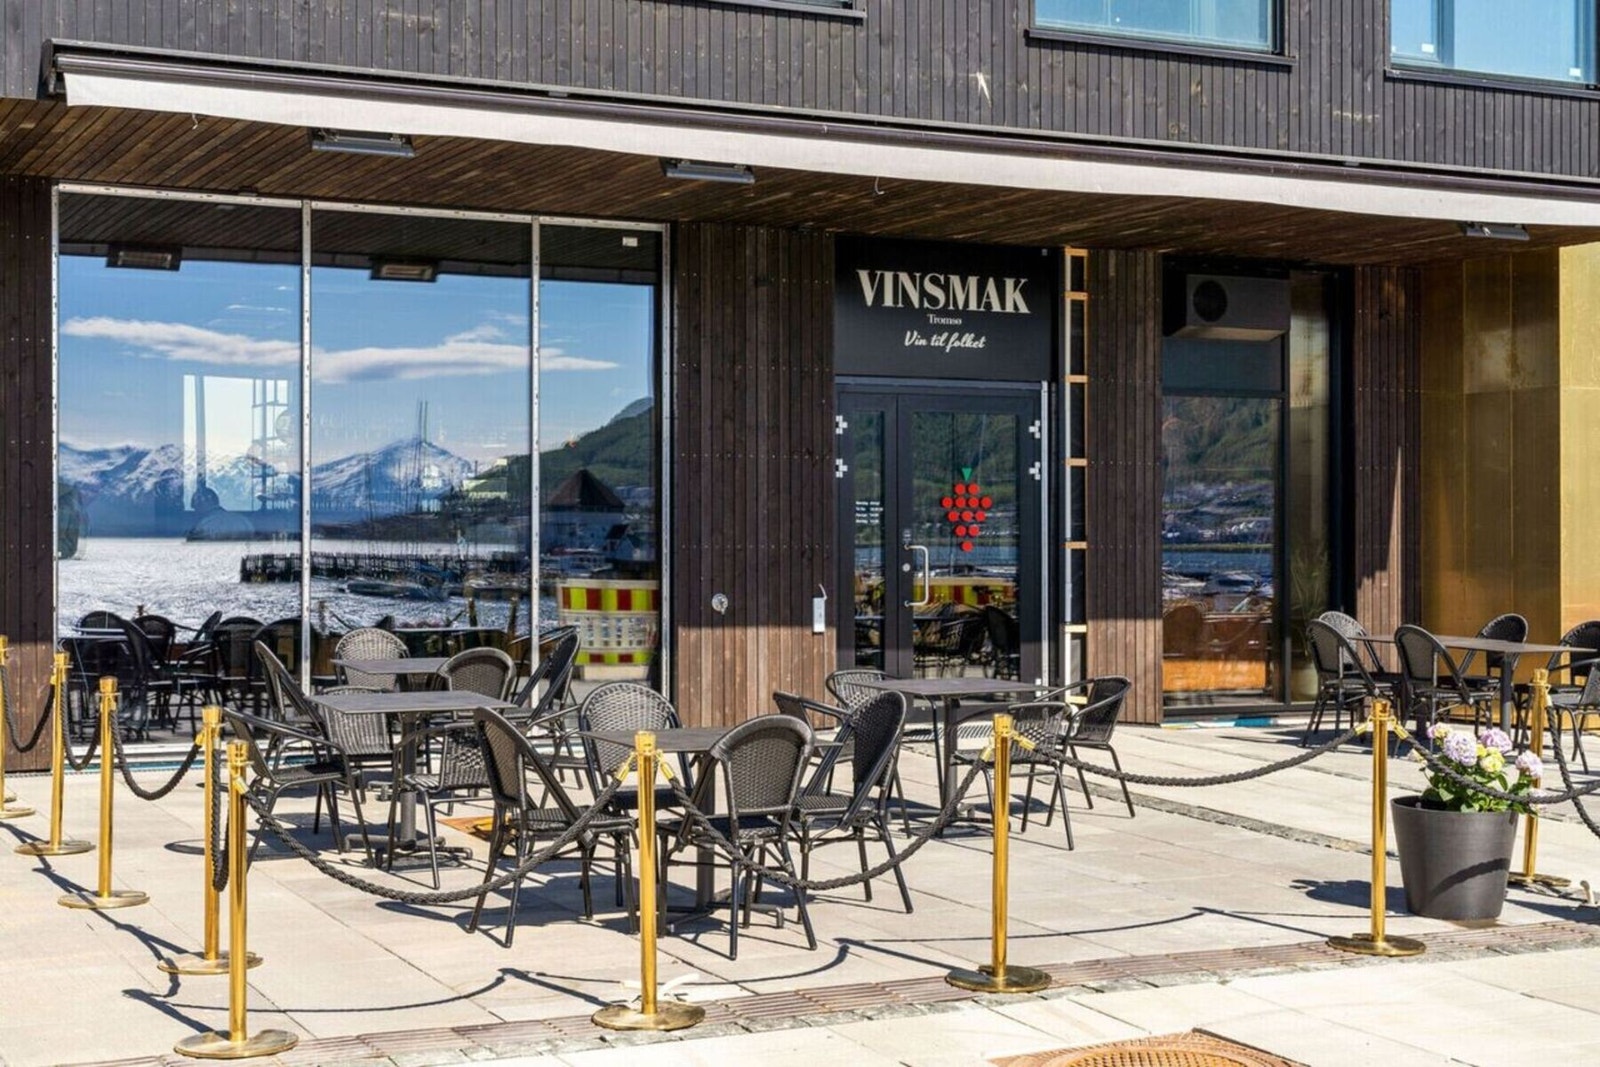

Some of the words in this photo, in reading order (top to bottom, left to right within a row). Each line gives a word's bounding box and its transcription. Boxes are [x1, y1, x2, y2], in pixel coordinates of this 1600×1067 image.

[856, 269, 1031, 314] VINSMAK
[904, 330, 928, 347] Vin
[930, 331, 949, 347] til
[945, 332, 987, 352] folket
